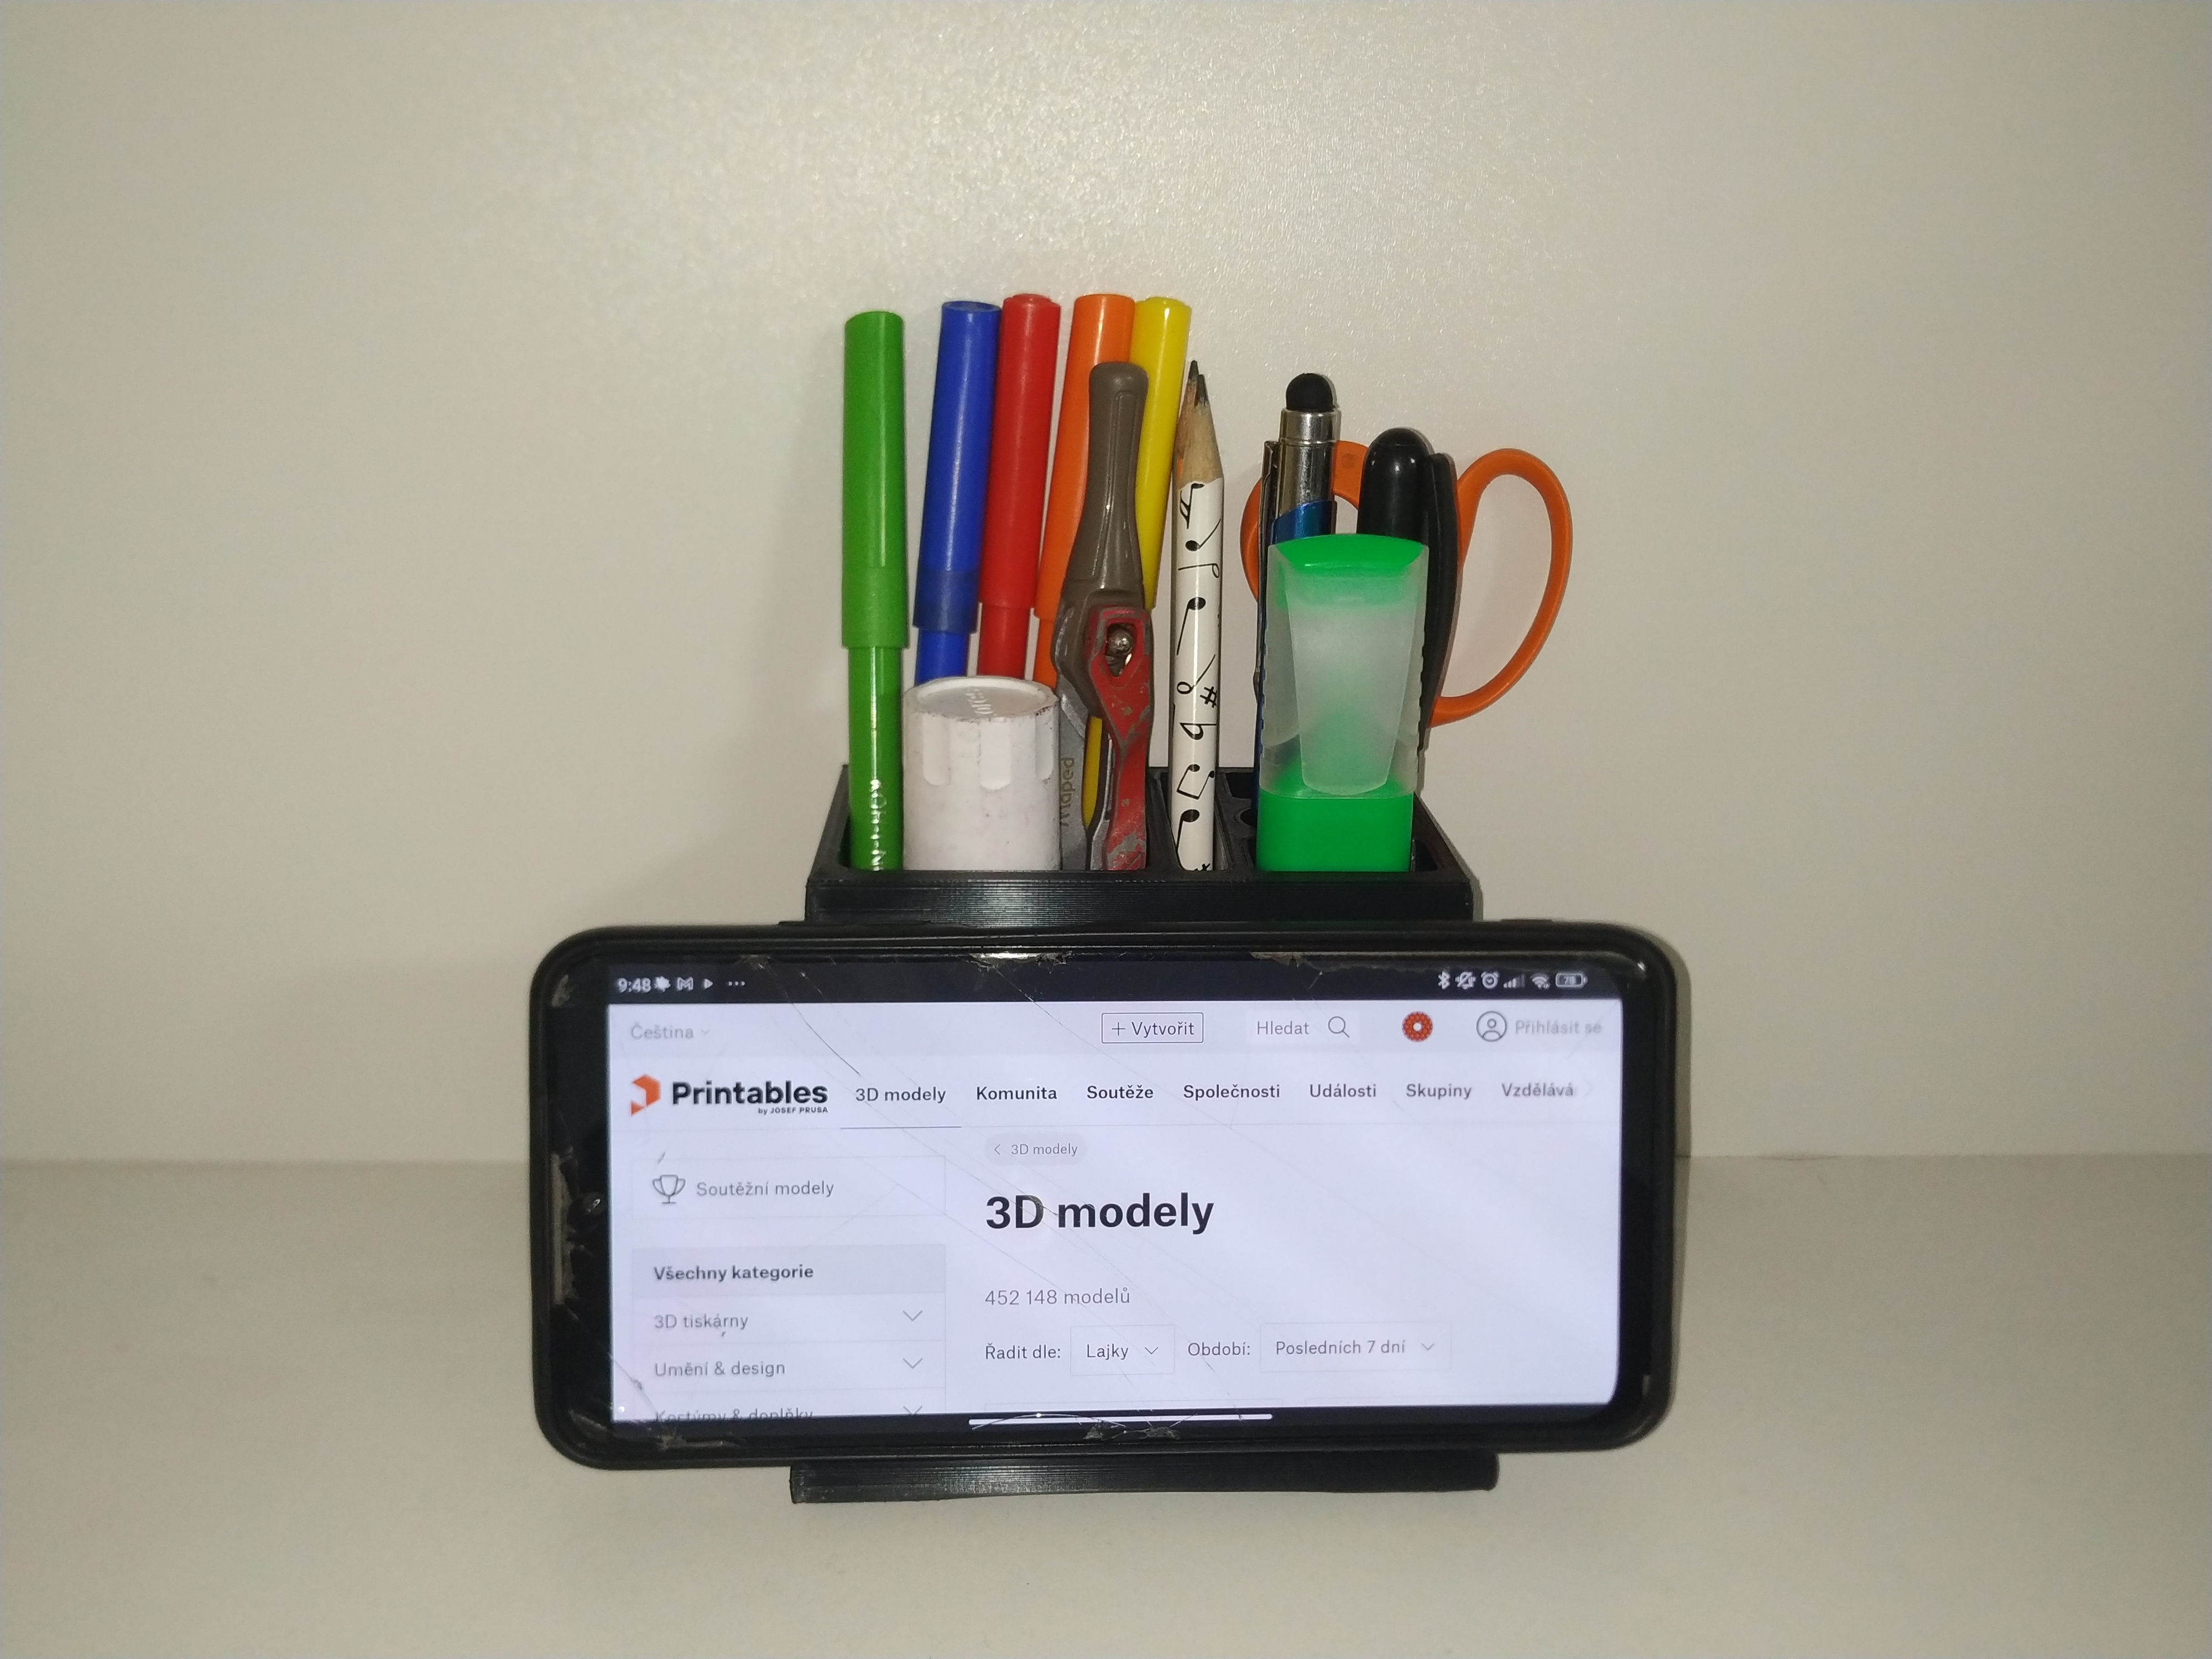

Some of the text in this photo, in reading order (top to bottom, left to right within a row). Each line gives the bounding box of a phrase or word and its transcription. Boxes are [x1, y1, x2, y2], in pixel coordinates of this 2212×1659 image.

[617, 977, 651, 993] 9:48
[629, 1021, 694, 1040] Čeština
[1131, 1021, 1194, 1039] Vytvořit
[1257, 1020, 1310, 1035] Hledat
[1515, 1020, 1603, 1035] Přihlásit se
[672, 1080, 828, 1105] Printables
[855, 1086, 946, 1104] 3D modely
[977, 1086, 1057, 1100] Komunita
[1087, 1084, 1154, 1099] Soutěže
[1183, 1084, 1280, 1102] Společnosti
[1310, 1083, 1376, 1098] Události
[1406, 1083, 1472, 1100] Skupiny
[1501, 1082, 1574, 1097] Vzdělává
[1011, 1142, 1078, 1157] 3D modely
[697, 1180, 834, 1198] Soutěžní modely
[986, 1192, 1214, 1235] 3D modely
[654, 1264, 814, 1282] Všechny kategorie
[984, 1287, 1130, 1306] 452 148 modelů
[654, 1313, 748, 1331] 3D tiskárny
[985, 1342, 1061, 1360] Řadit dle:
[1087, 1343, 1129, 1361] Lajky
[1188, 1341, 1250, 1357] Období:
[1276, 1339, 1405, 1355] Posledních 7 dní
[655, 1360, 785, 1378] Umění & design
